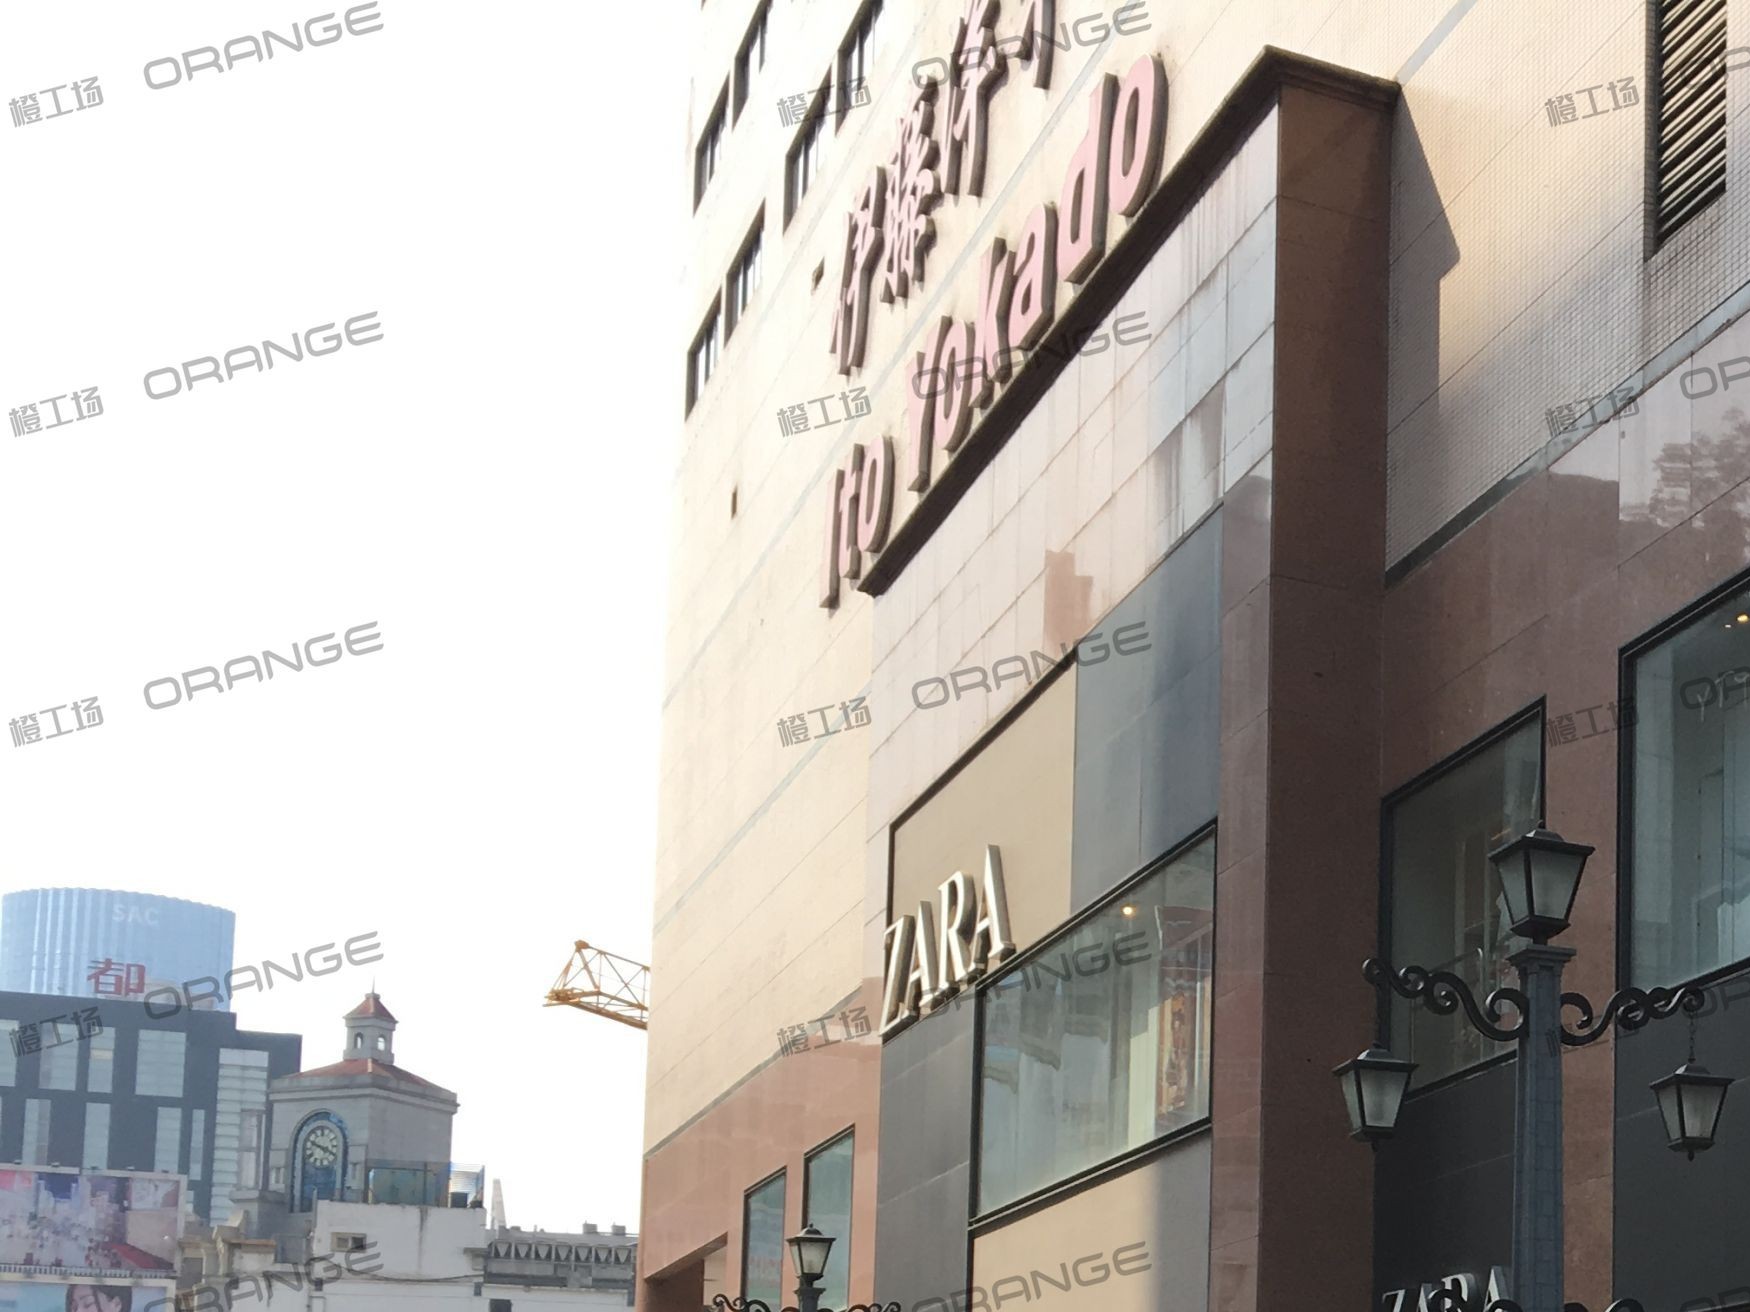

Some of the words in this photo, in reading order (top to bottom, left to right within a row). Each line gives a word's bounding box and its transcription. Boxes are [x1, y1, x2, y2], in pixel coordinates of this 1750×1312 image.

[819, 435, 894, 609] Ito
[907, 53, 1170, 492] Yokado
[86, 958, 147, 997] 都
[878, 845, 1015, 1037] ZARA
